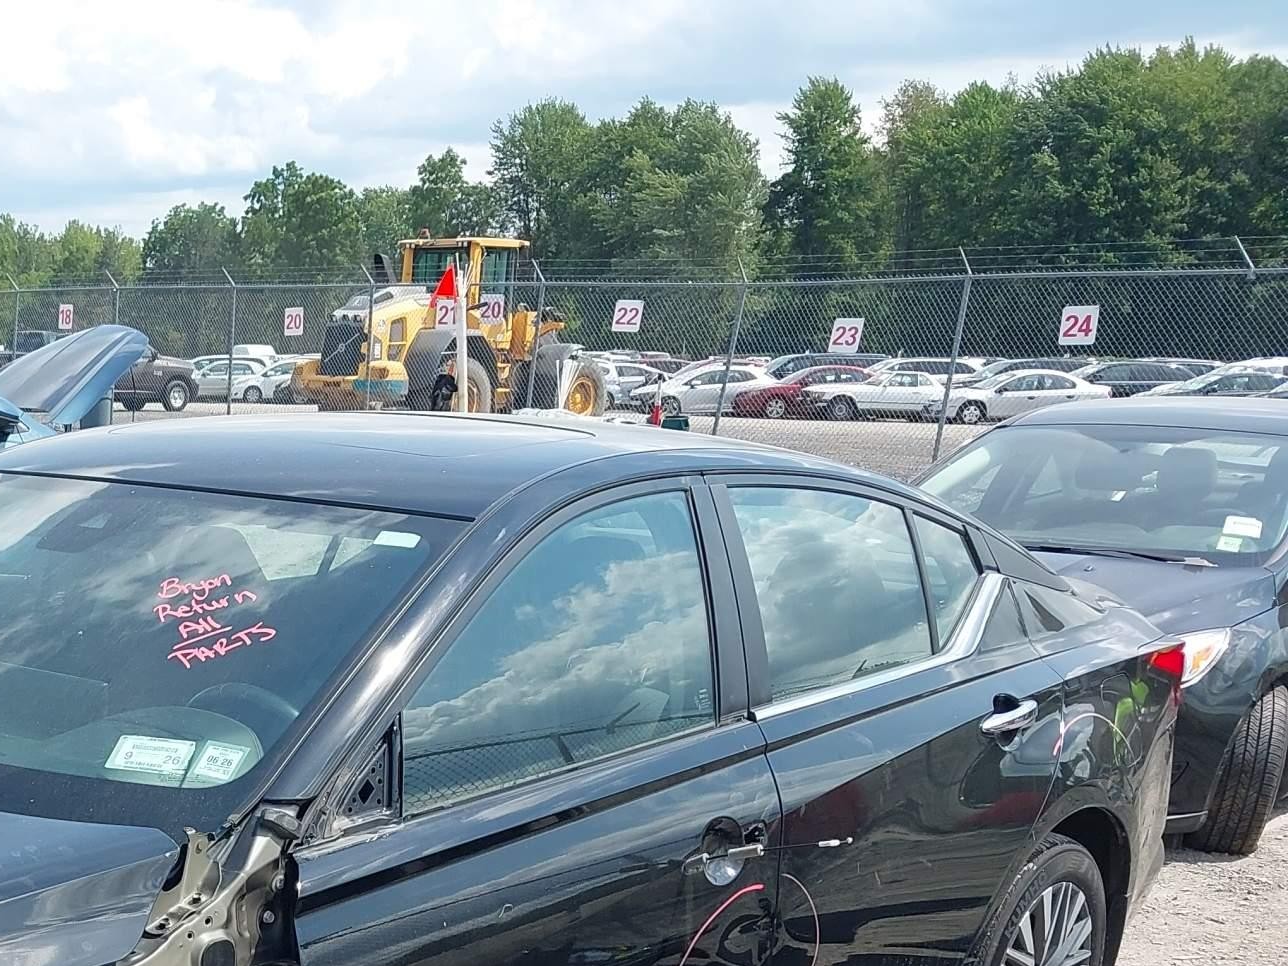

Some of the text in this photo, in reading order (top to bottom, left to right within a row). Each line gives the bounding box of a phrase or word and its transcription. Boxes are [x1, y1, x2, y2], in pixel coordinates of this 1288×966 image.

[60, 309, 72, 324] 18
[438, 305, 456, 325] 21
[481, 301, 501, 319] 20
[615, 307, 639, 325] 22
[286, 313, 302, 330] 20
[1062, 314, 1093, 337] 24
[832, 326, 859, 346] 23
[153, 590, 257, 623] Return
[167, 621, 277, 669] PARTS
[123, 751, 134, 760] 9
[162, 755, 182, 766] 26
